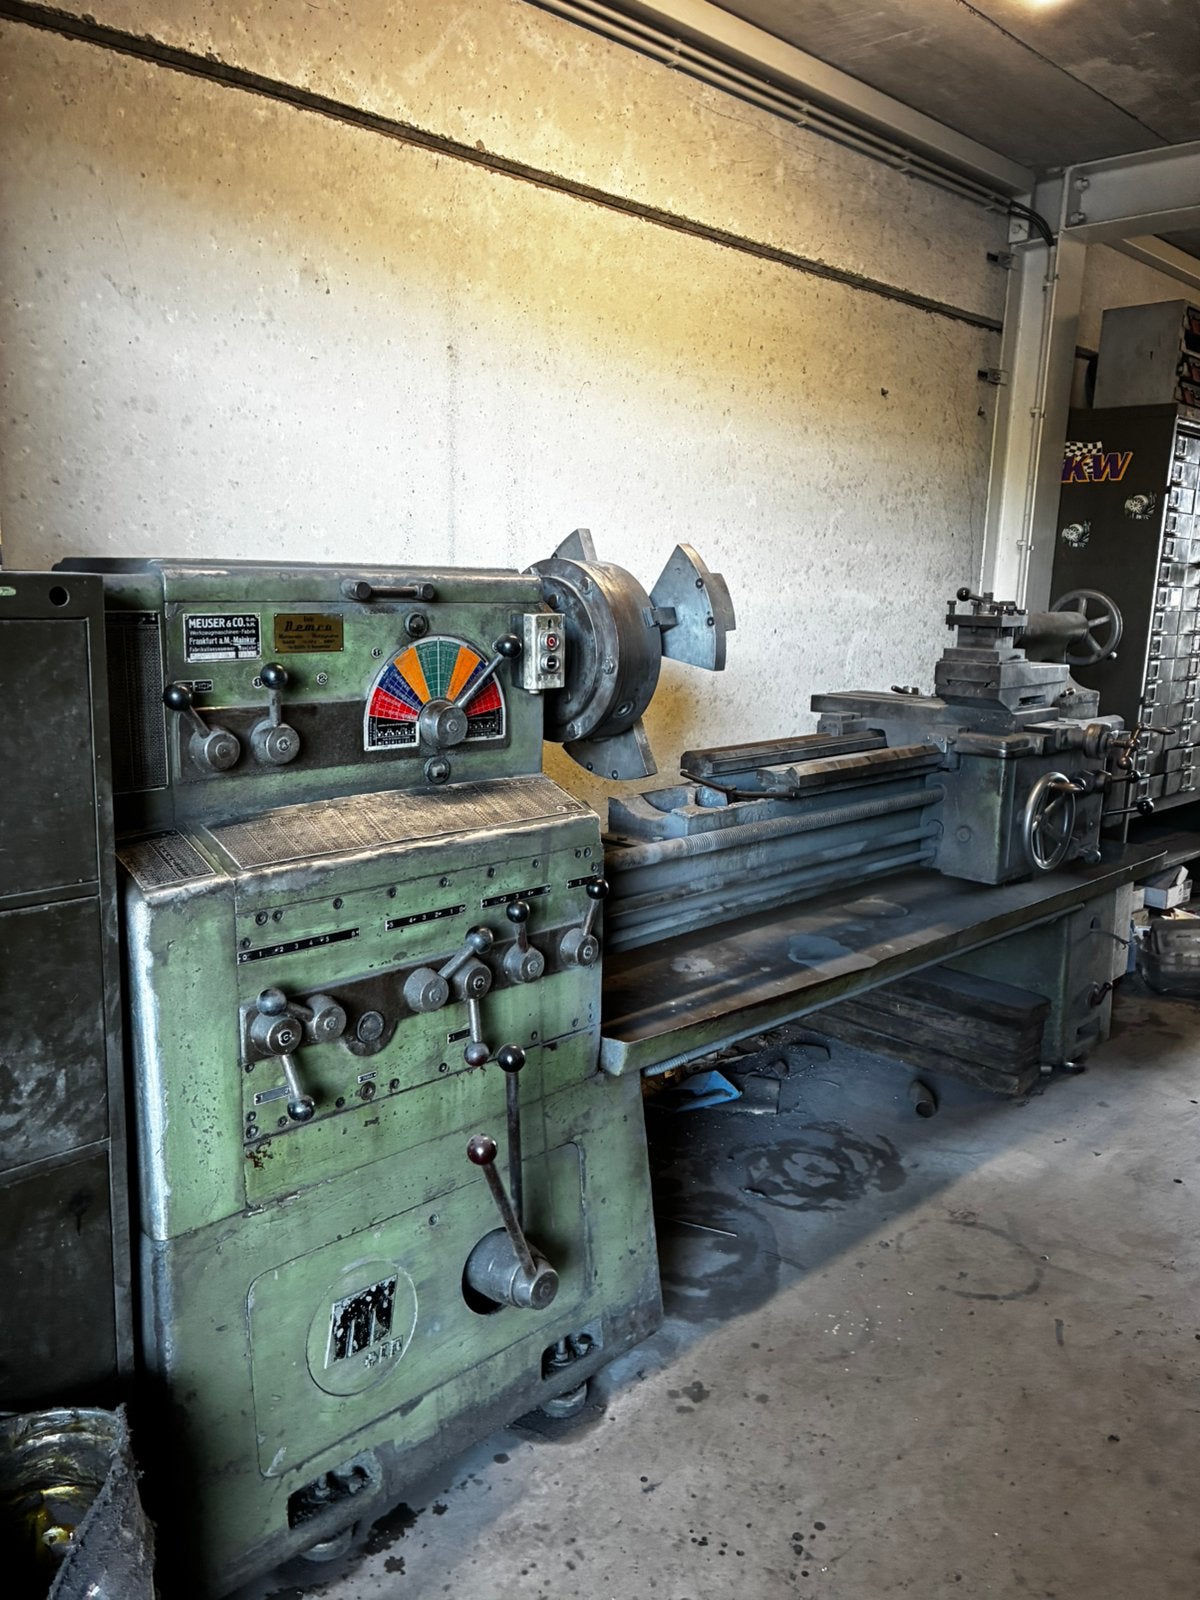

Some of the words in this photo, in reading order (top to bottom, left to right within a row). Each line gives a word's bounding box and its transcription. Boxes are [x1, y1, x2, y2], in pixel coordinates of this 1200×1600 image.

[188, 618, 225, 629] MEUSER
[226, 620, 232, 628] &
[232, 617, 246, 628] CO.
[189, 637, 218, 646] Frankfurt
